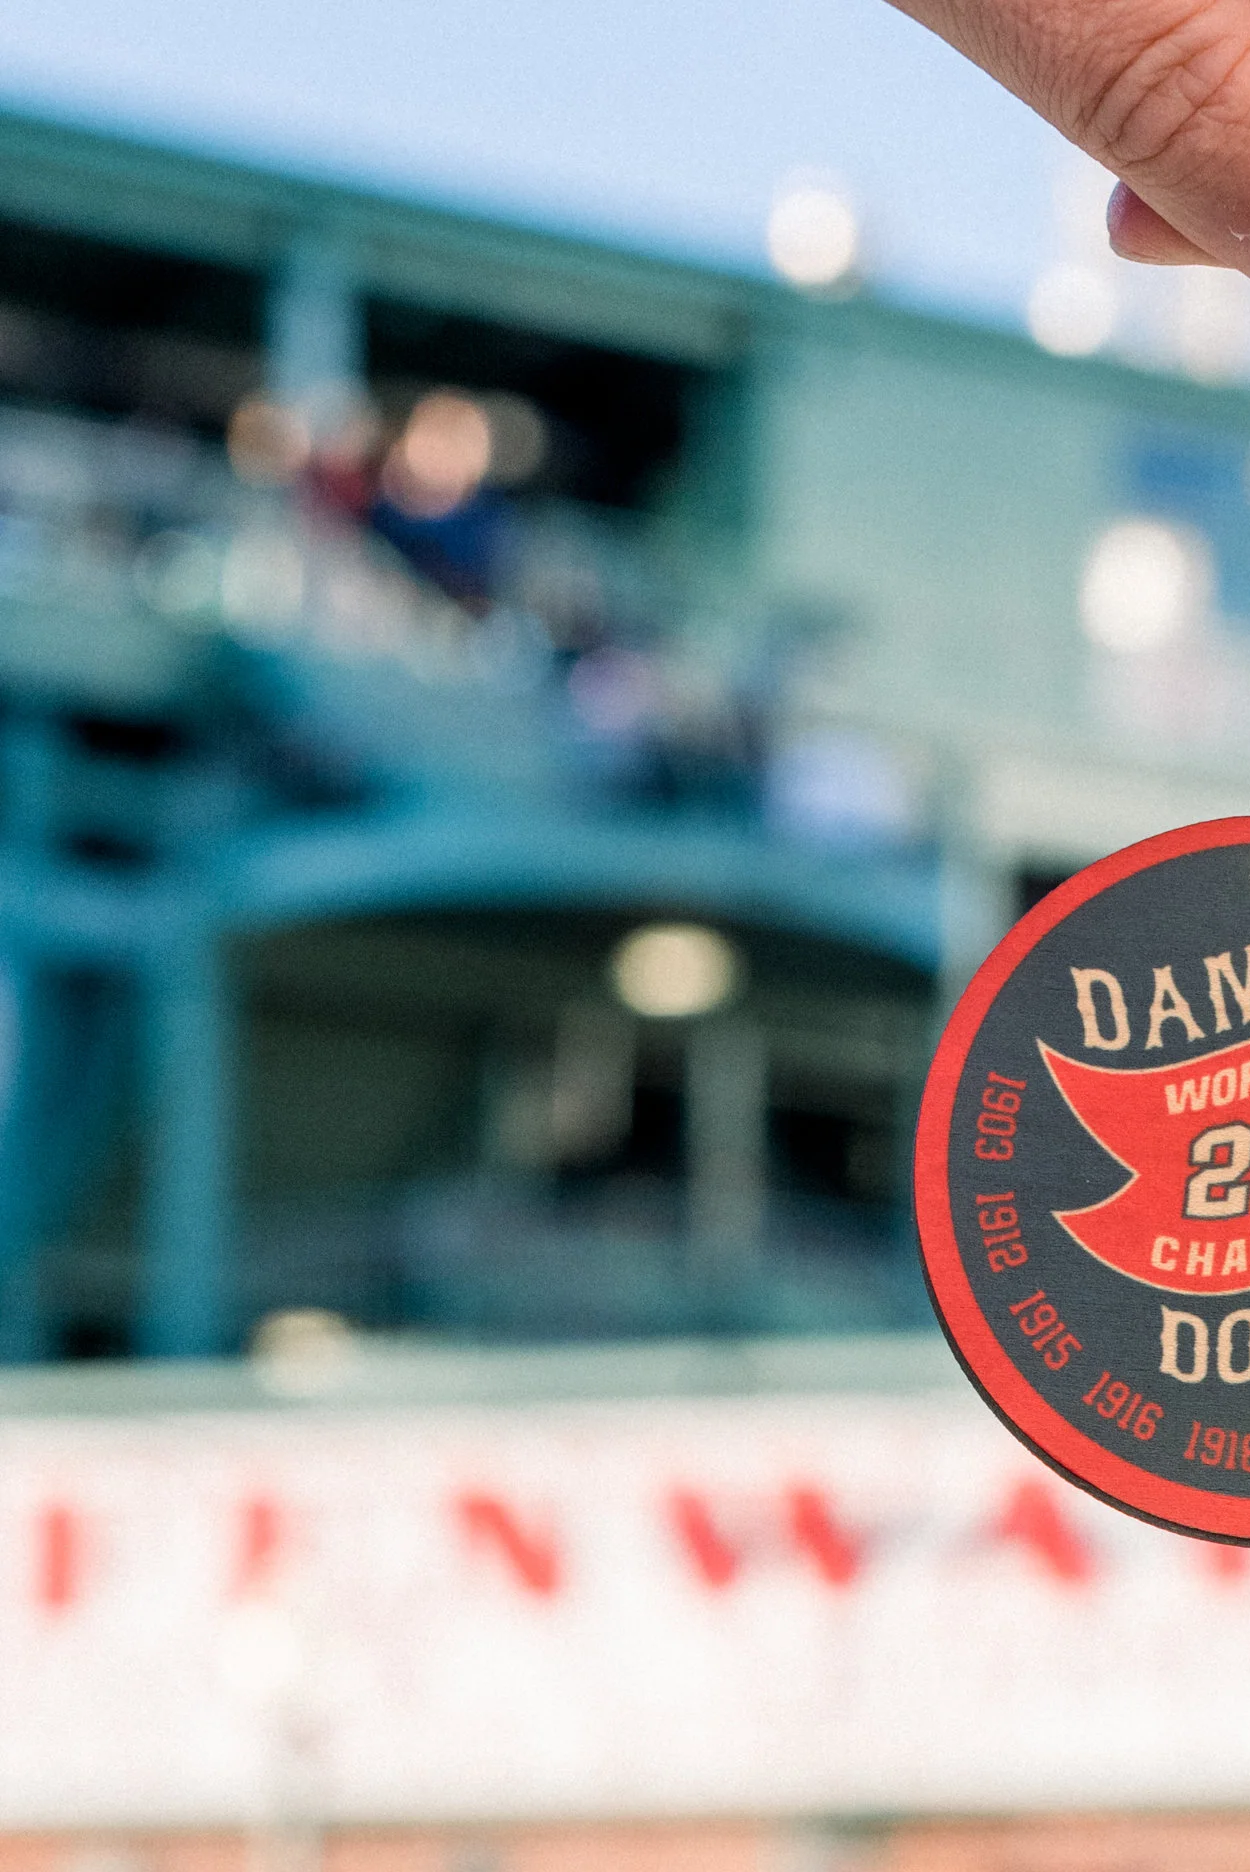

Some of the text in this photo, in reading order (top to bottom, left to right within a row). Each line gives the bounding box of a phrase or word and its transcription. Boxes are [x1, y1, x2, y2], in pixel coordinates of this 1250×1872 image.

[974, 1071, 1027, 1161] 1903
[975, 1191, 1029, 1273] 1912
[1009, 1289, 1083, 1371] 1915
[1083, 1371, 1163, 1441] 1916
